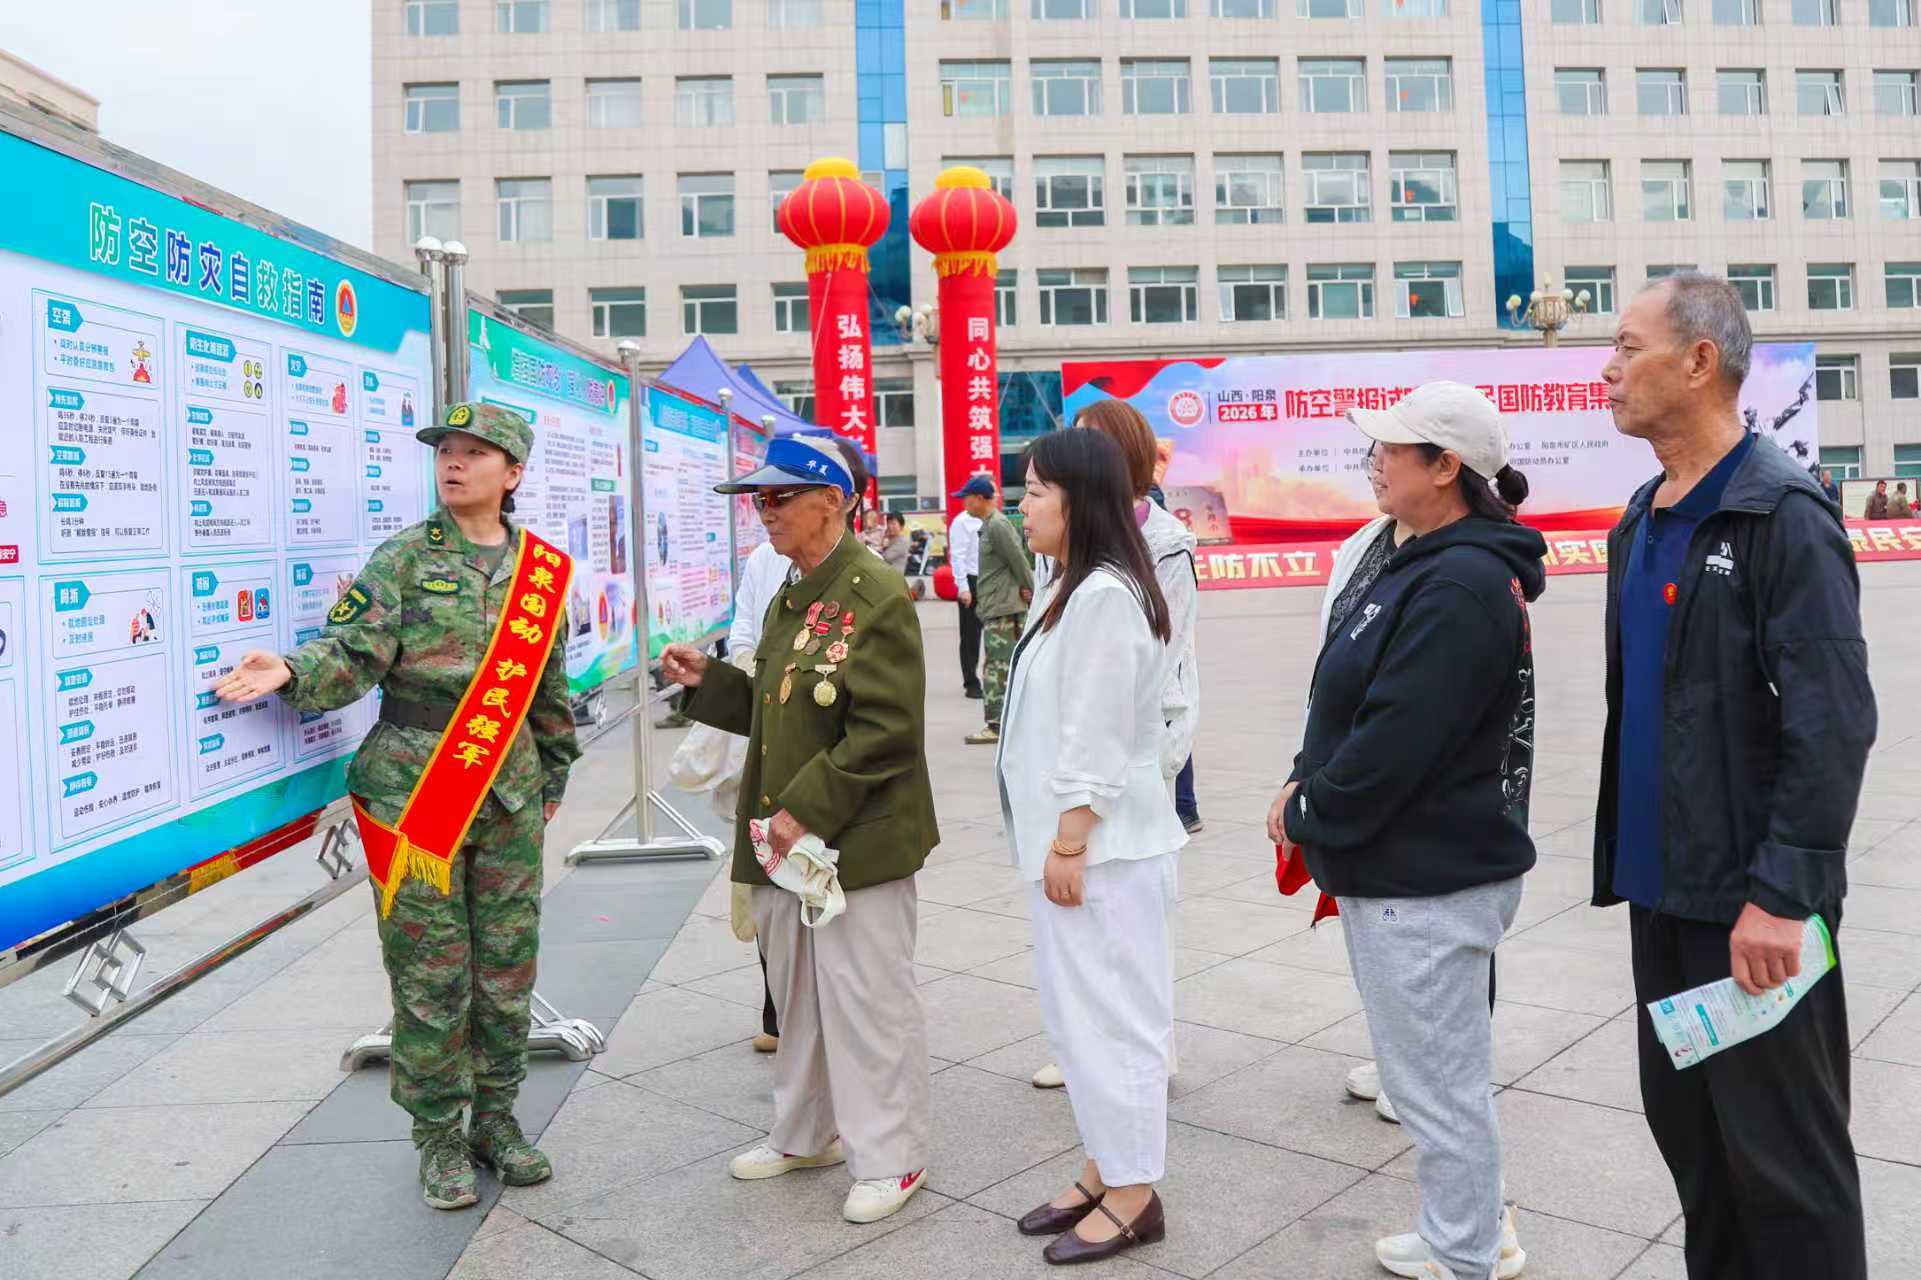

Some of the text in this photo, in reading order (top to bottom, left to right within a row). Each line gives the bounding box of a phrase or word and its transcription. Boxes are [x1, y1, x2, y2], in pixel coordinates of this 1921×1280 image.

[90, 202, 326, 325] 防空防灾自救指南
[1220, 404, 1277, 421] 2026年
[1285, 386, 1413, 418] 防空警报试
[452, 543, 562, 770] 阳泉国动 护民强军
